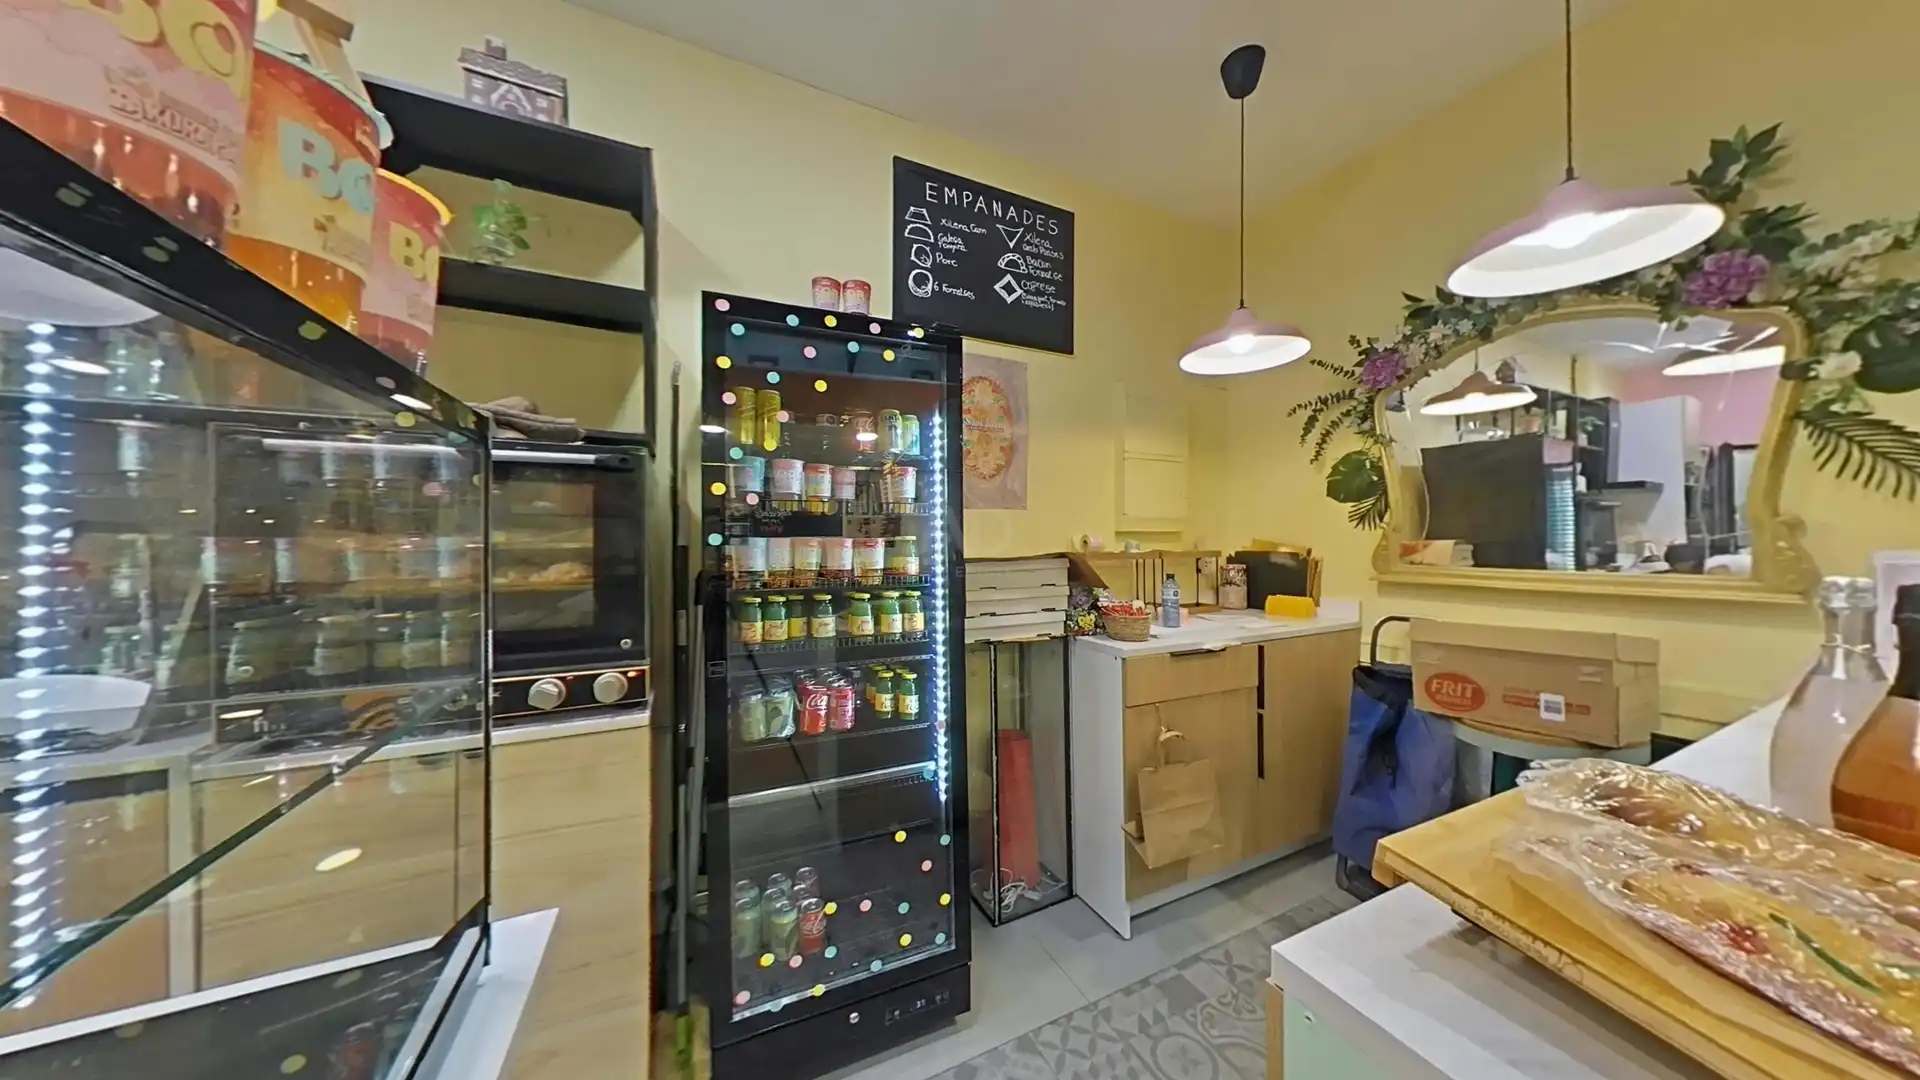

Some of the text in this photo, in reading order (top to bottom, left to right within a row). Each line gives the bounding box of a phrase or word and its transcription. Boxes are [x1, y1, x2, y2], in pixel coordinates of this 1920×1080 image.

[925, 181, 1059, 235] EMPANADES
[936, 251, 958, 267] Porc
[933, 281, 940, 291] 6
[1431, 679, 1479, 698] FRIT
